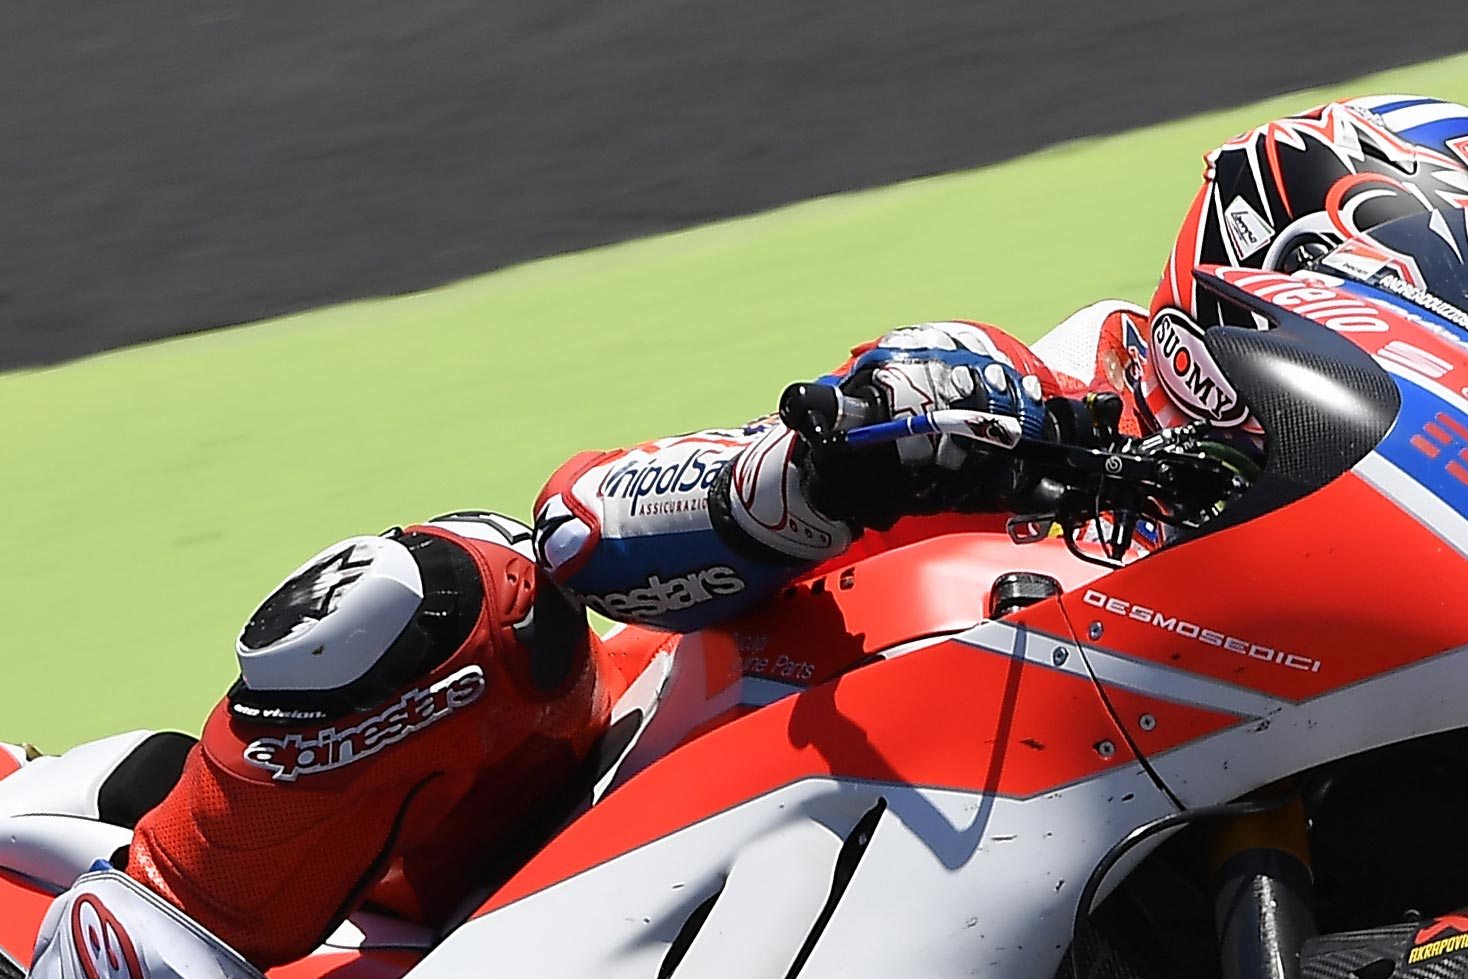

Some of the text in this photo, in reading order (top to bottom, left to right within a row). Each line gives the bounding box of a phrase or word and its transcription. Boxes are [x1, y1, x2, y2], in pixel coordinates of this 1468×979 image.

[1155, 315, 1235, 420] SUOMY
[639, 498, 708, 516] ASSICURAZIO
[1083, 588, 1322, 674] DESMOSEDICI
[243, 664, 487, 782] alpinestars
